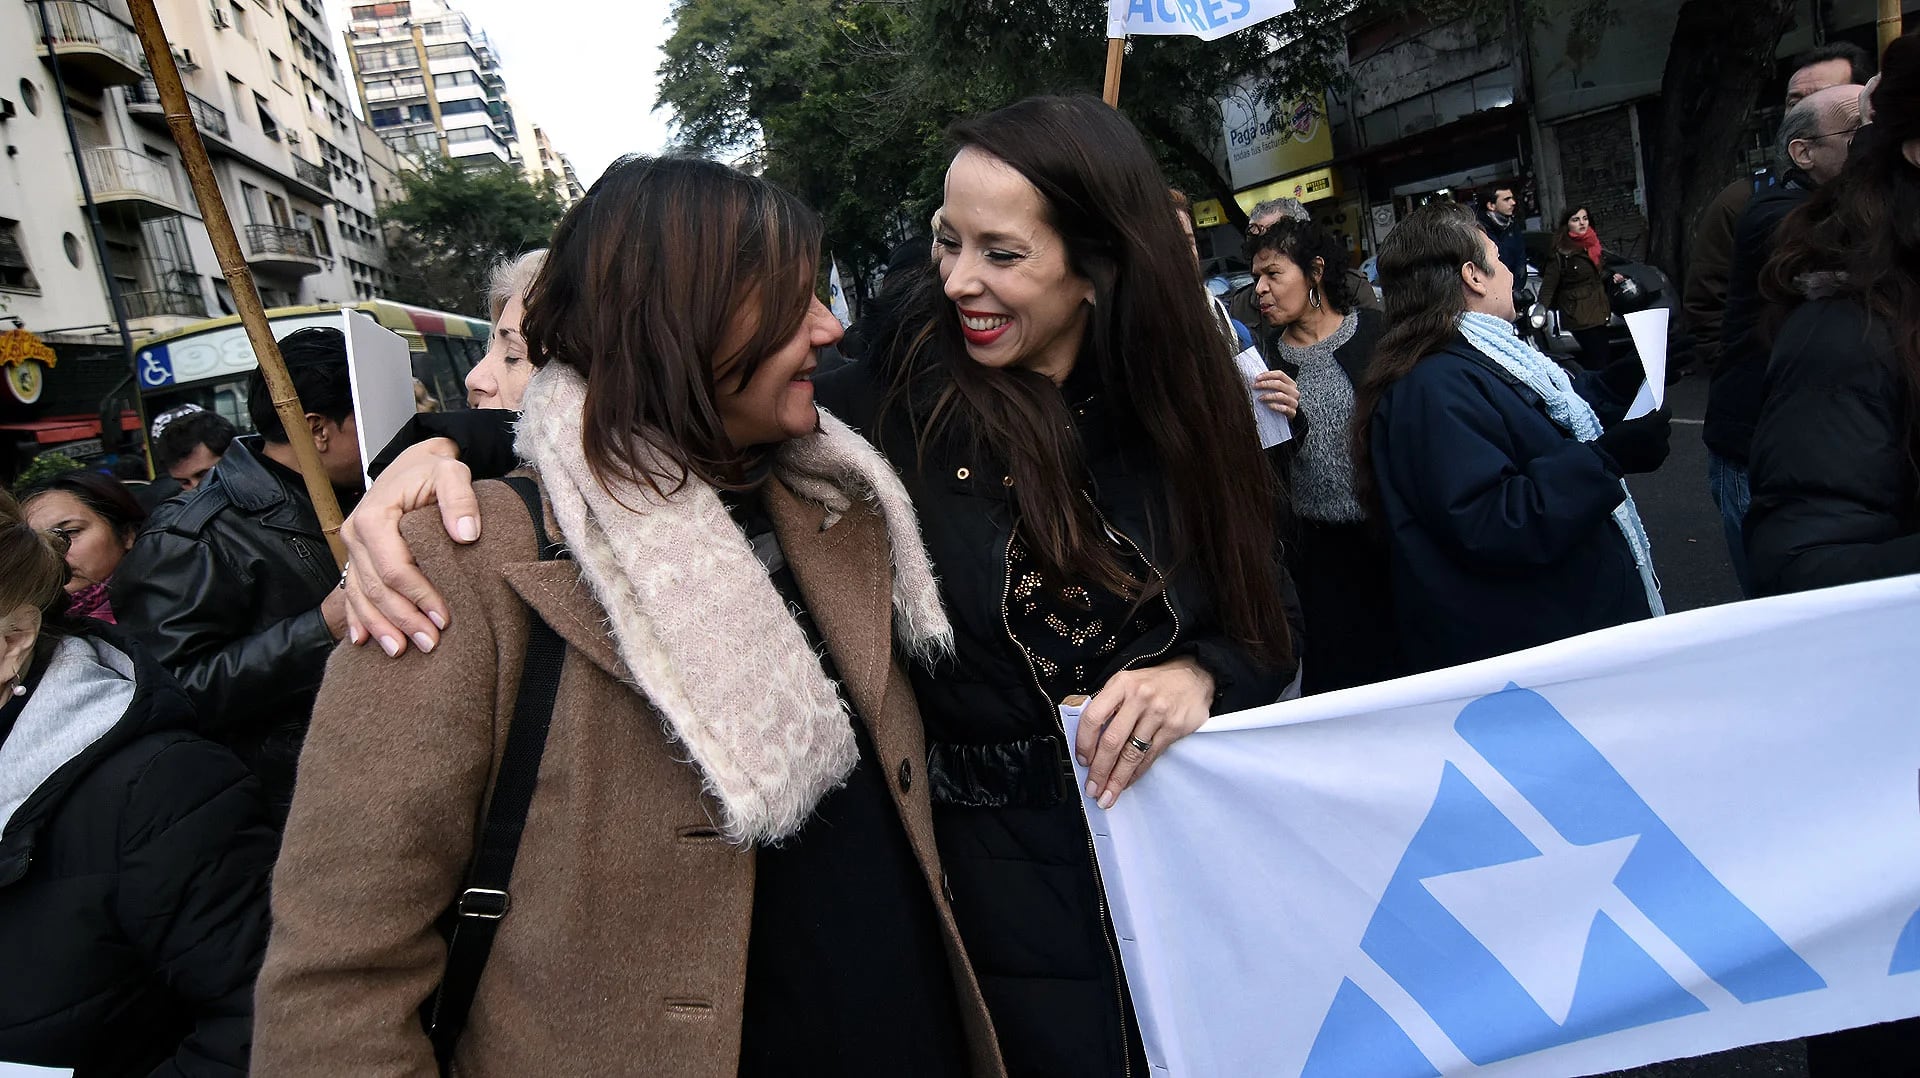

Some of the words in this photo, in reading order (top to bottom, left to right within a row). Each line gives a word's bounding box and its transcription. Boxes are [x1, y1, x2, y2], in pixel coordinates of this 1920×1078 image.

[1230, 121, 1256, 146] Pagá
[1233, 149, 1251, 162] todas
[1251, 145, 1262, 156] tus
[1262, 137, 1289, 152] facturas
